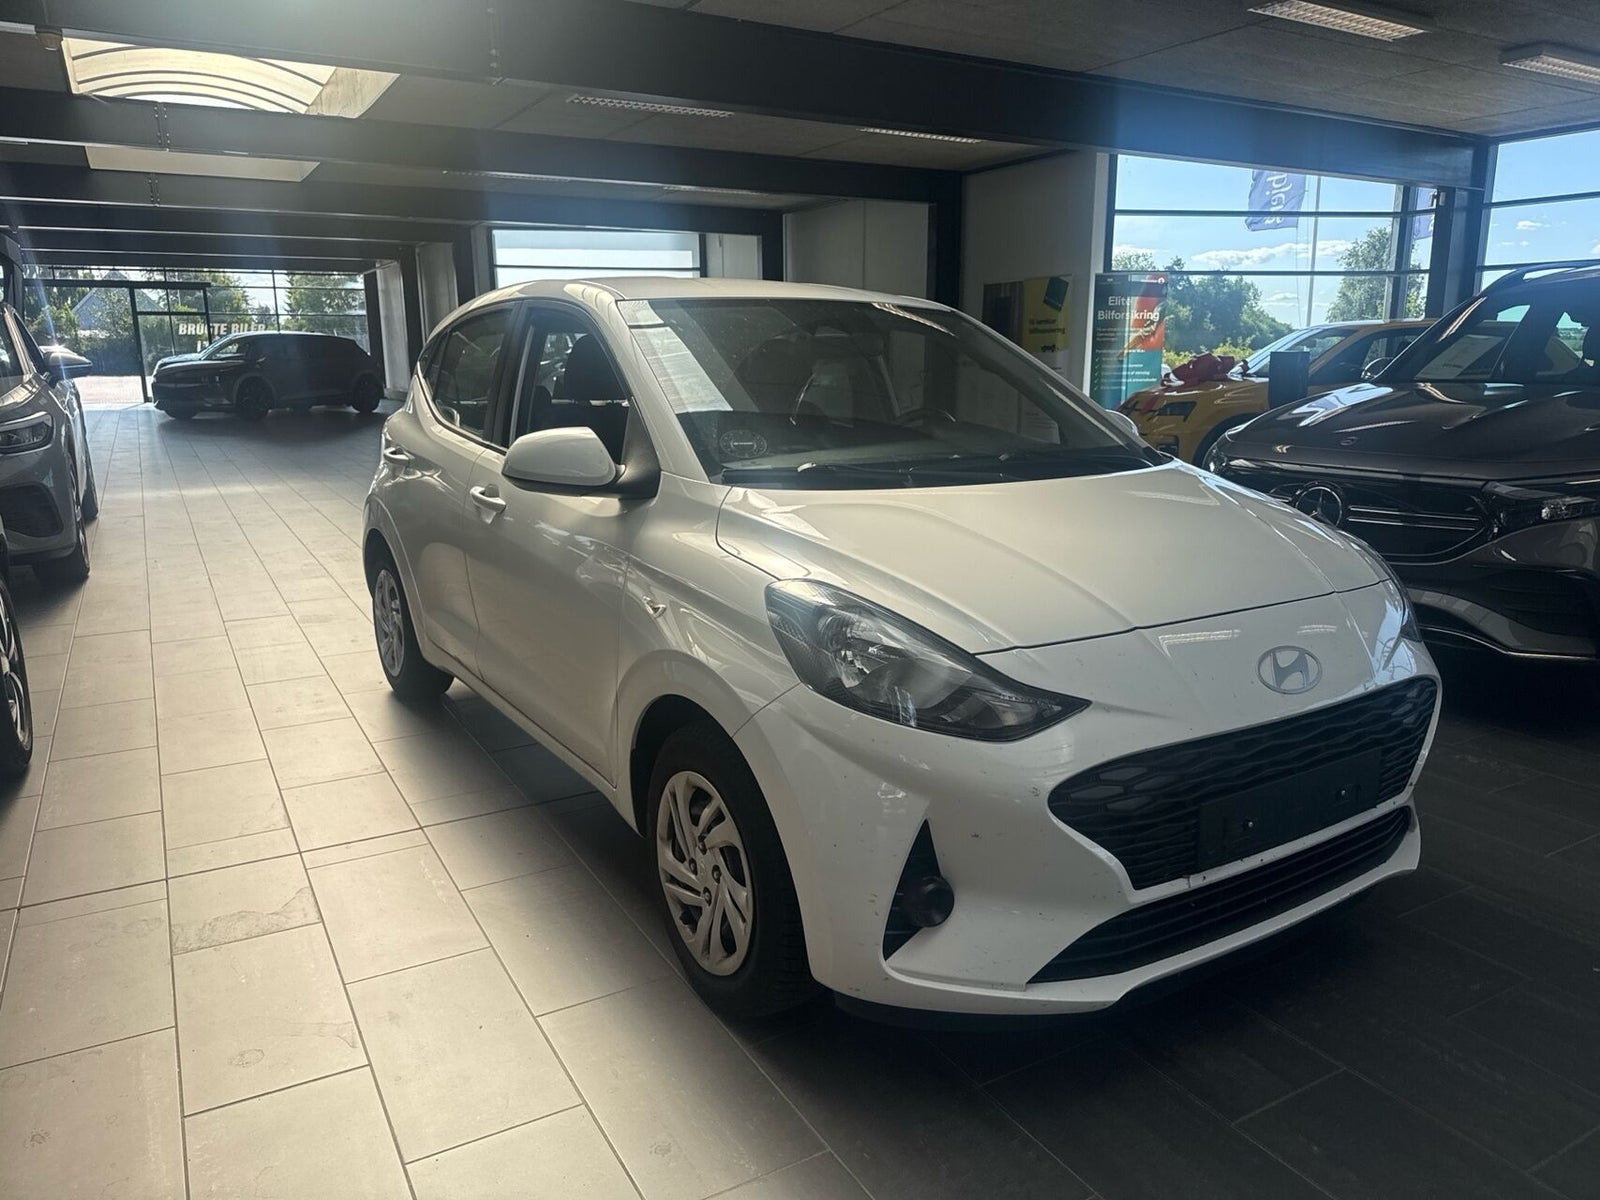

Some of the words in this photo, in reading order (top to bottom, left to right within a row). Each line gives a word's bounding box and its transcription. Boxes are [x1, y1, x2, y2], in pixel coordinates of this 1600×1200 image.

[1108, 295, 1131, 306] Elite
[1097, 309, 1160, 322] Bilforsikring
[178, 323, 228, 335] BRUGTE
